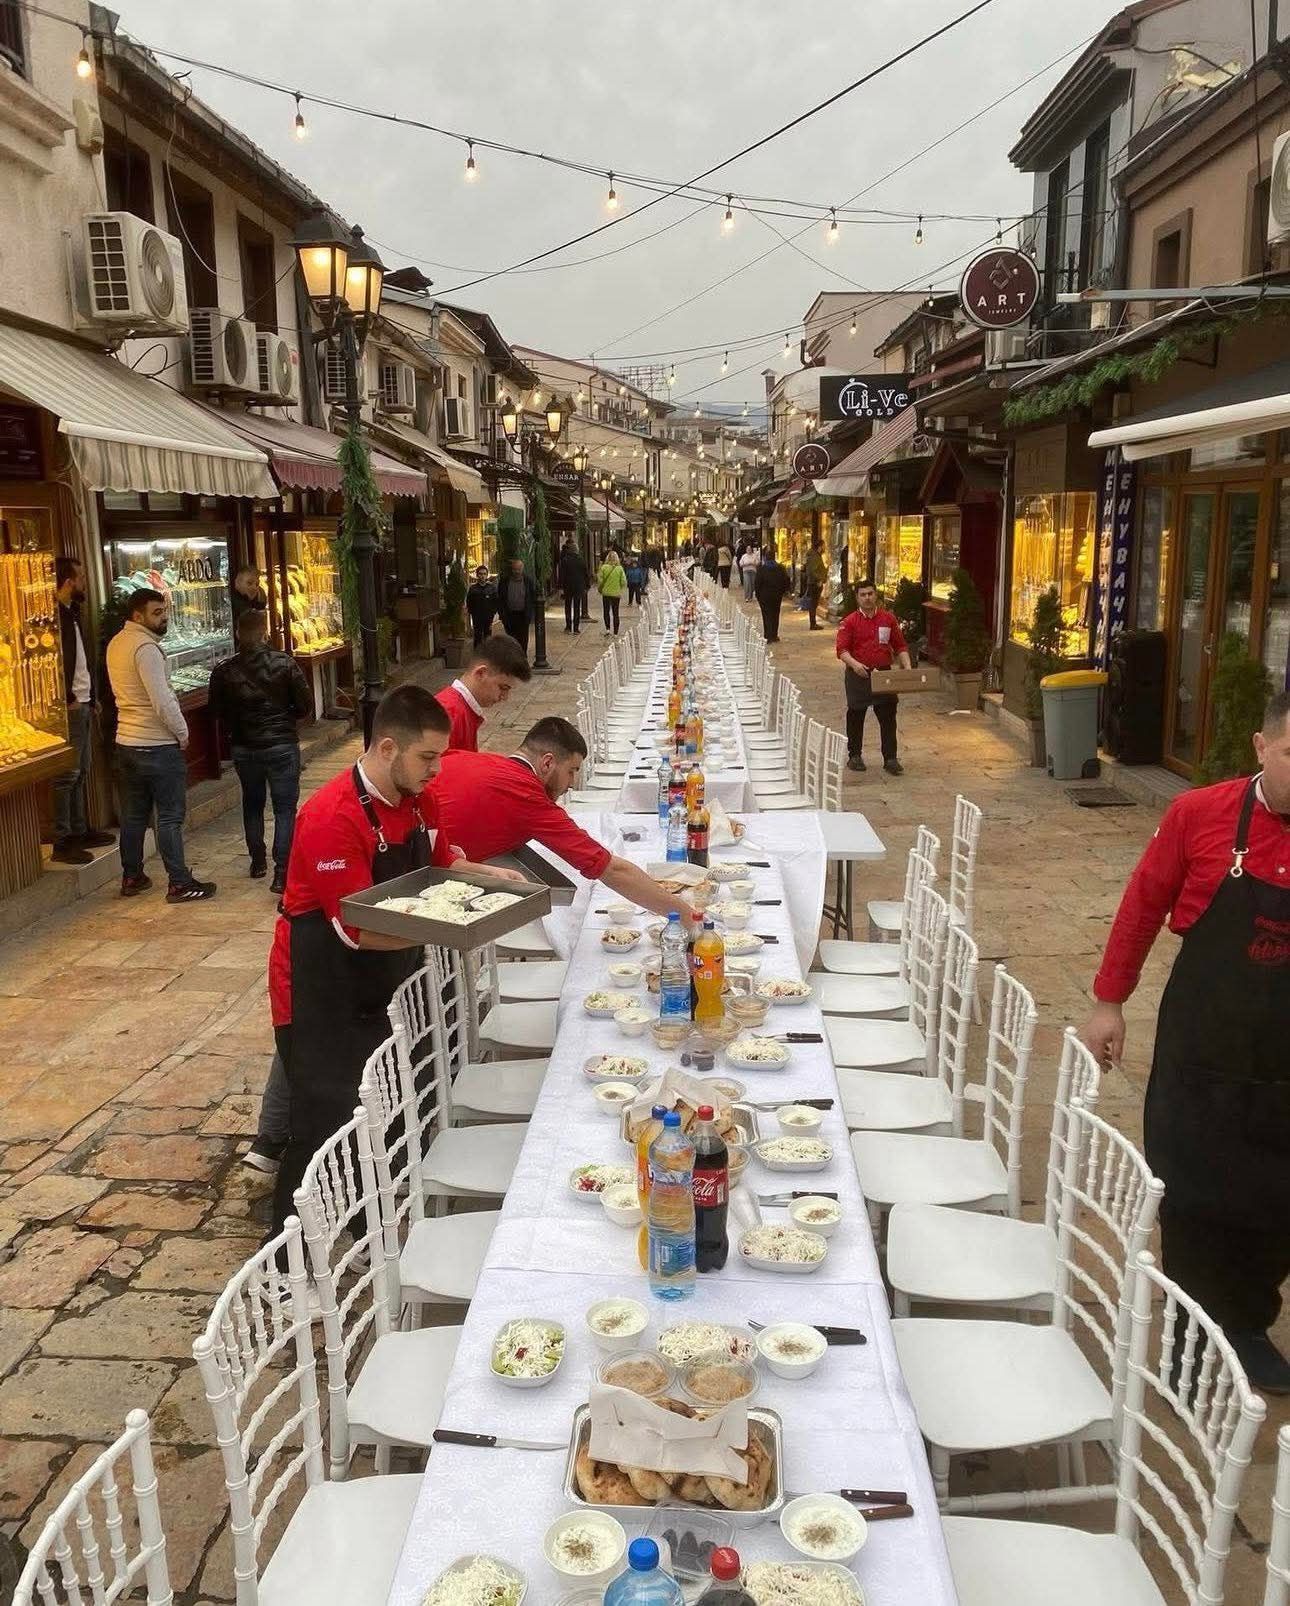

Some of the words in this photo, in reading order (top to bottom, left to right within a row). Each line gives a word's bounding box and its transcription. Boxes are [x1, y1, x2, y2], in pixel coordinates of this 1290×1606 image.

[977, 292, 1026, 308] ART
[846, 389, 909, 410] Li-Ve
[855, 408, 894, 416] GOLD
[800, 463, 824, 472] ART
